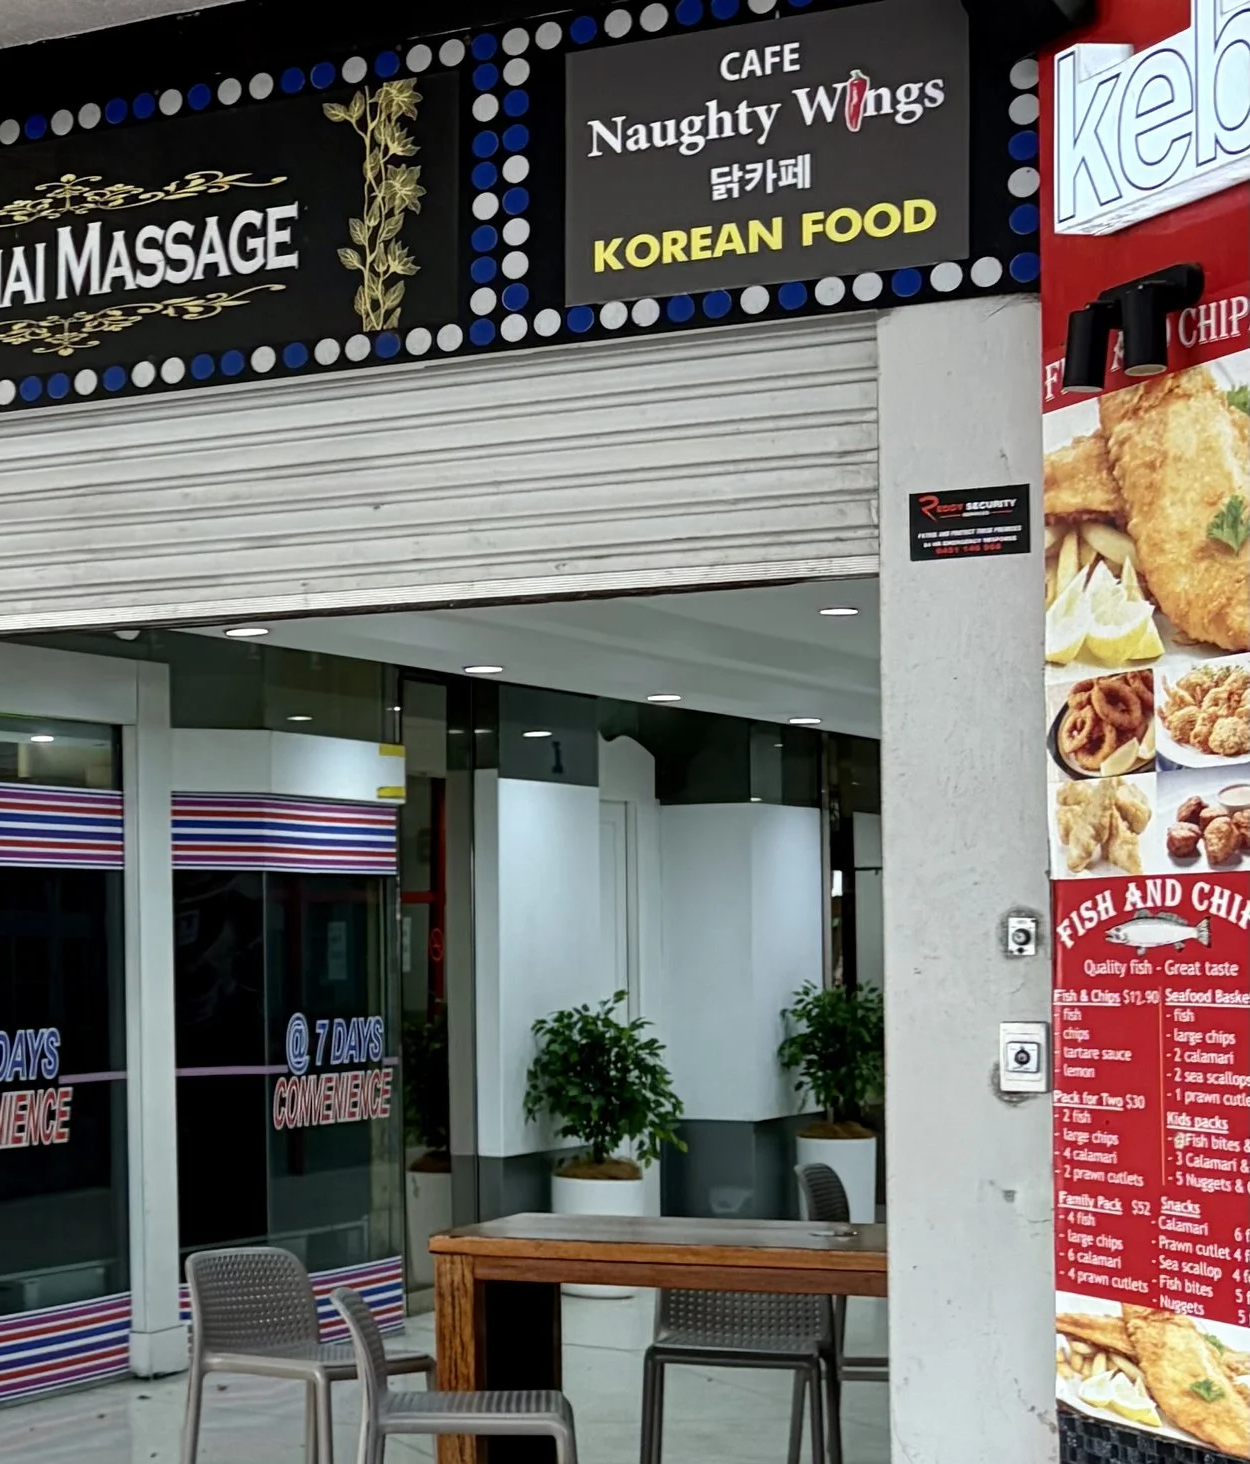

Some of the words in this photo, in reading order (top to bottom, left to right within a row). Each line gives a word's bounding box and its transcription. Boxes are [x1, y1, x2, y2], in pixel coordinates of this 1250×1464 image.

[720, 42, 800, 82] CAFE
[587, 98, 781, 157] Naughty
[710, 153, 811, 201] 닭카페
[594, 217, 783, 273] KOREAN
[802, 198, 937, 246] FOOD
[56, 201, 299, 300] MASSAGE
[1178, 295, 1250, 348] CHIP
[965, 499, 1017, 511] SECURITY
[1056, 890, 1117, 949] FISH
[1123, 878, 1182, 911] AND
[1083, 959, 1127, 978] Quality
[1130, 959, 1153, 975] fish
[1164, 959, 1201, 976] Great
[1205, 961, 1239, 977] taste
[1053, 989, 1077, 1002] Fish
[1080, 989, 1089, 1003] &
[1091, 989, 1121, 1004] Chips
[1165, 988, 1212, 1003] Seafood
[1215, 989, 1250, 1004] Baske
[1063, 1008, 1082, 1021] fish
[1174, 1008, 1195, 1022] fish
[285, 1011, 309, 1075] @
[314, 1019, 330, 1065] 7
[330, 1015, 384, 1064] DAYS
[1063, 1027, 1090, 1043] chips
[1174, 1029, 1203, 1046] large
[1205, 1030, 1236, 1047] chips
[1063, 1047, 1099, 1060] tartare
[1102, 1049, 1132, 1061] sauce
[1174, 1048, 1182, 1062] 2
[1184, 1049, 1235, 1065] calamari
[1063, 1064, 1095, 1078] lemon
[1174, 1068, 1182, 1082] 2
[1184, 1070, 1204, 1083] sea
[272, 1068, 393, 1131] CONVENIENCE
[1053, 1090, 1080, 1104] Pack
[1082, 1091, 1098, 1105] for
[1102, 1093, 1124, 1107] Two
[1126, 1094, 1145, 1109] $30
[1175, 1088, 1181, 1101] 1
[1184, 1090, 1220, 1104] prawn
[1063, 1109, 1070, 1122] 2
[1073, 1110, 1092, 1124] fish
[1166, 1112, 1191, 1127] Kids
[1194, 1114, 1228, 1131] packs
[1063, 1128, 1089, 1145] large
[1092, 1131, 1119, 1147] chips
[1185, 1133, 1208, 1149] Fish
[1211, 1135, 1240, 1153] bites
[1063, 1147, 1071, 1160] 4
[1073, 1149, 1117, 1164] calamari
[1176, 1153, 1182, 1166] 3
[1185, 1154, 1237, 1172] Calamari
[1240, 1158, 1250, 1173] &
[1063, 1165, 1071, 1178] 2
[1073, 1167, 1104, 1182] prawn
[1107, 1171, 1144, 1187] cutlets
[1176, 1172, 1183, 1186] 5
[1186, 1173, 1232, 1193] Nuggets
[1234, 1179, 1244, 1193] &
[1058, 1191, 1094, 1208] Family
[1097, 1195, 1122, 1211] Pack
[1131, 1200, 1151, 1216] $52
[1160, 1196, 1200, 1213] Snacks
[1067, 1211, 1075, 1224] 4
[1077, 1212, 1096, 1226] fish
[1158, 1216, 1208, 1236] Calamari
[1234, 1227, 1243, 1242] 6
[1067, 1229, 1094, 1248] large
[1096, 1233, 1124, 1251] chips
[1158, 1235, 1193, 1254] Prawn
[1196, 1242, 1232, 1261] cutlet
[1233, 1248, 1242, 1263] 4
[1067, 1249, 1075, 1262] 6
[1077, 1251, 1122, 1269] calamari
[1158, 1255, 1179, 1271] Sea
[1181, 1260, 1223, 1281] scallop
[1232, 1268, 1241, 1282] 4
[1067, 1267, 1075, 1281] 4
[1077, 1270, 1109, 1286] prawn
[1111, 1274, 1149, 1293] cutlets
[1159, 1274, 1182, 1292] Fish
[1185, 1279, 1214, 1298] bites
[1235, 1288, 1243, 1304] 5
[1159, 1294, 1205, 1316] Nuggets
[1237, 1309, 1246, 1324] 5
